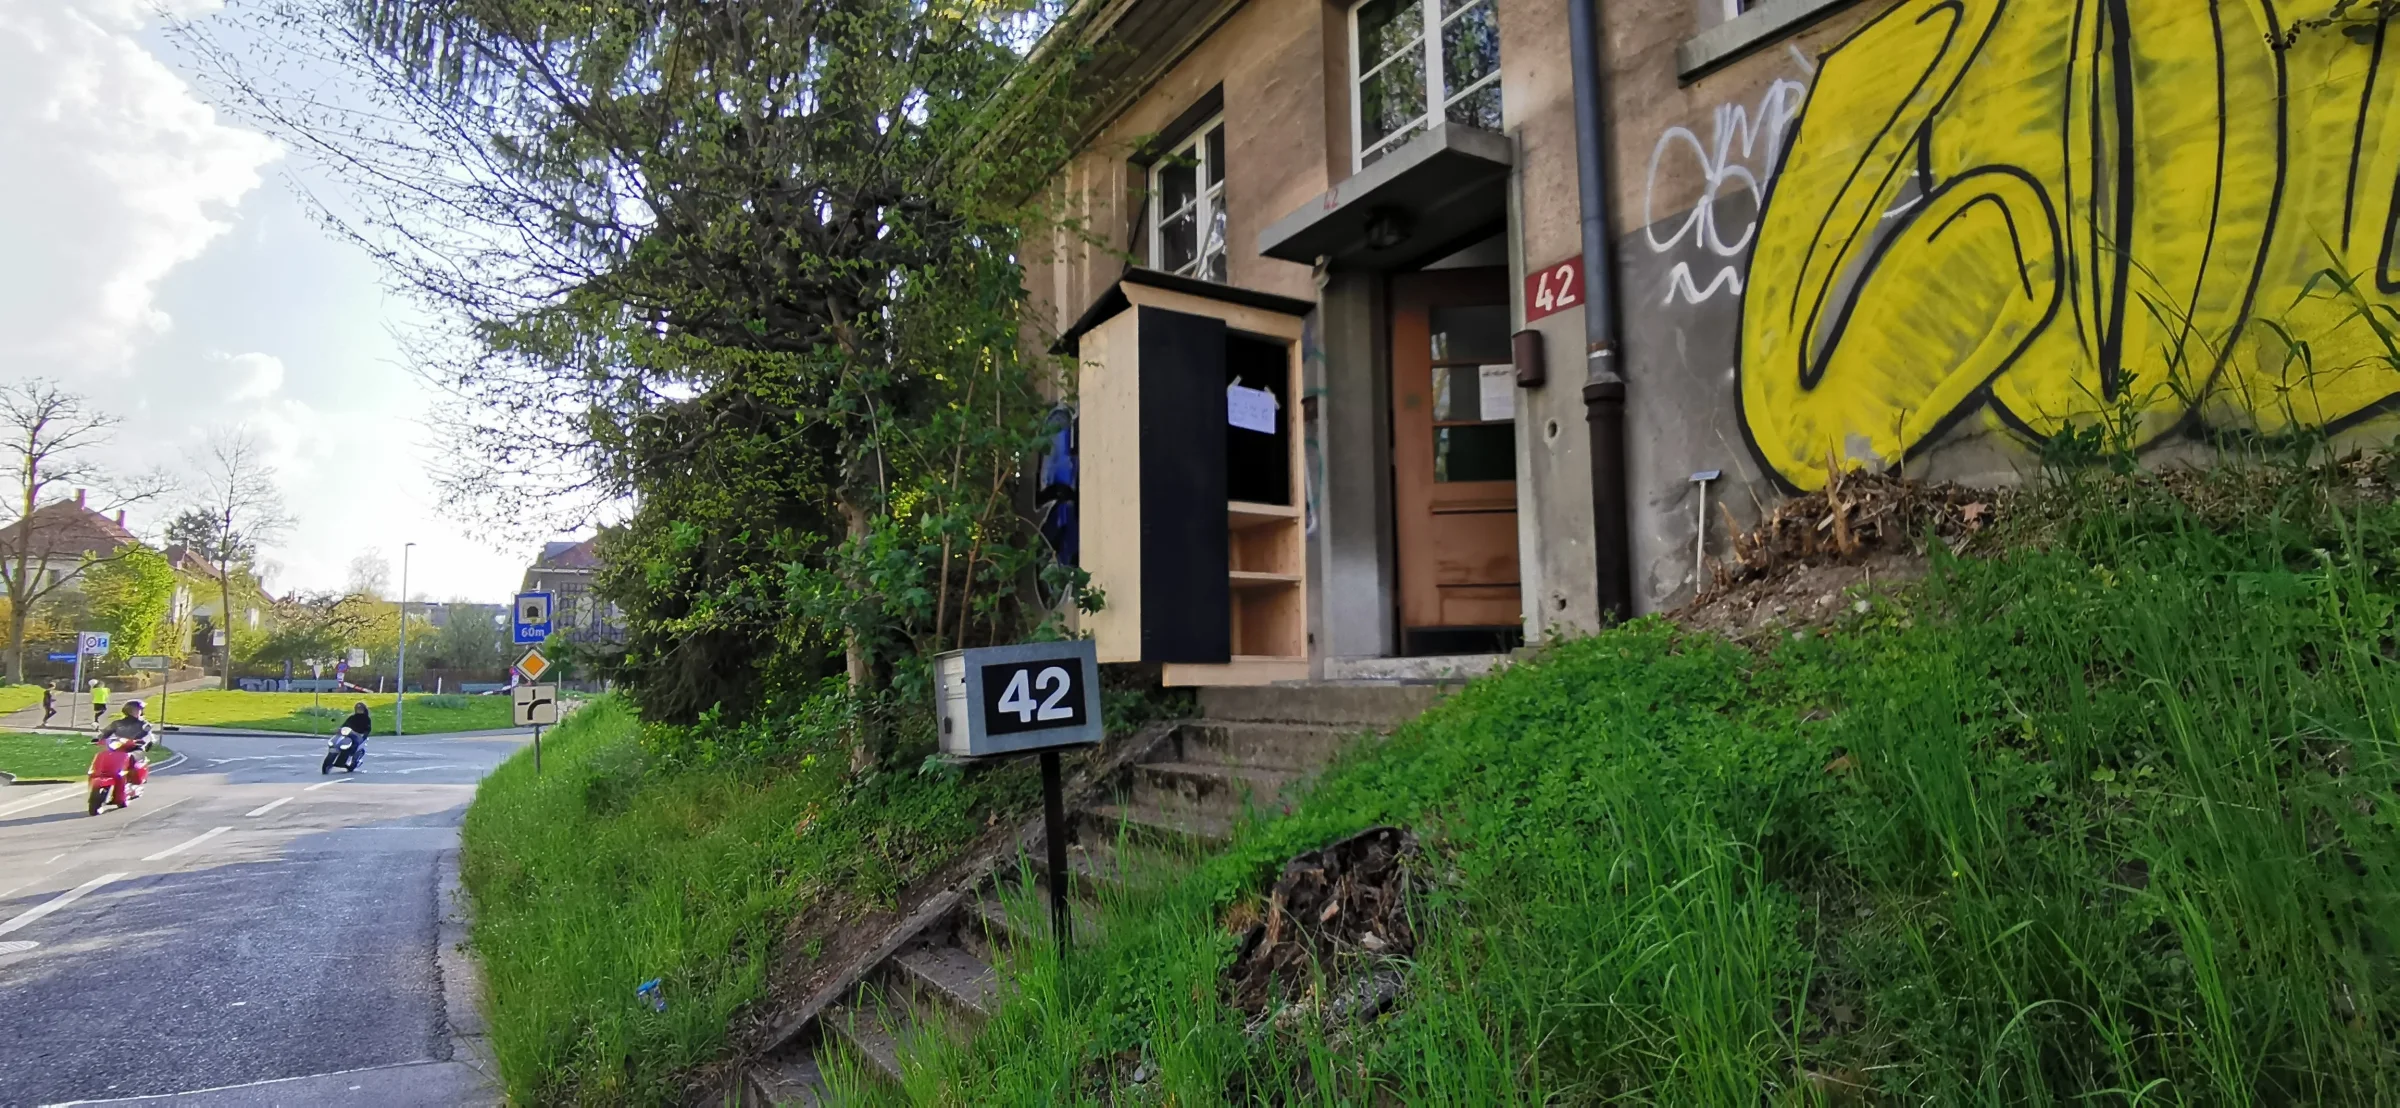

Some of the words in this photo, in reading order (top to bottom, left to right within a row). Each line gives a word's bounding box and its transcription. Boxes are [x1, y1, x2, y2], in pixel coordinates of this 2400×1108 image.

[1534, 263, 1576, 311] 42
[521, 627, 545, 638] 60m
[997, 666, 1074, 723] 42
